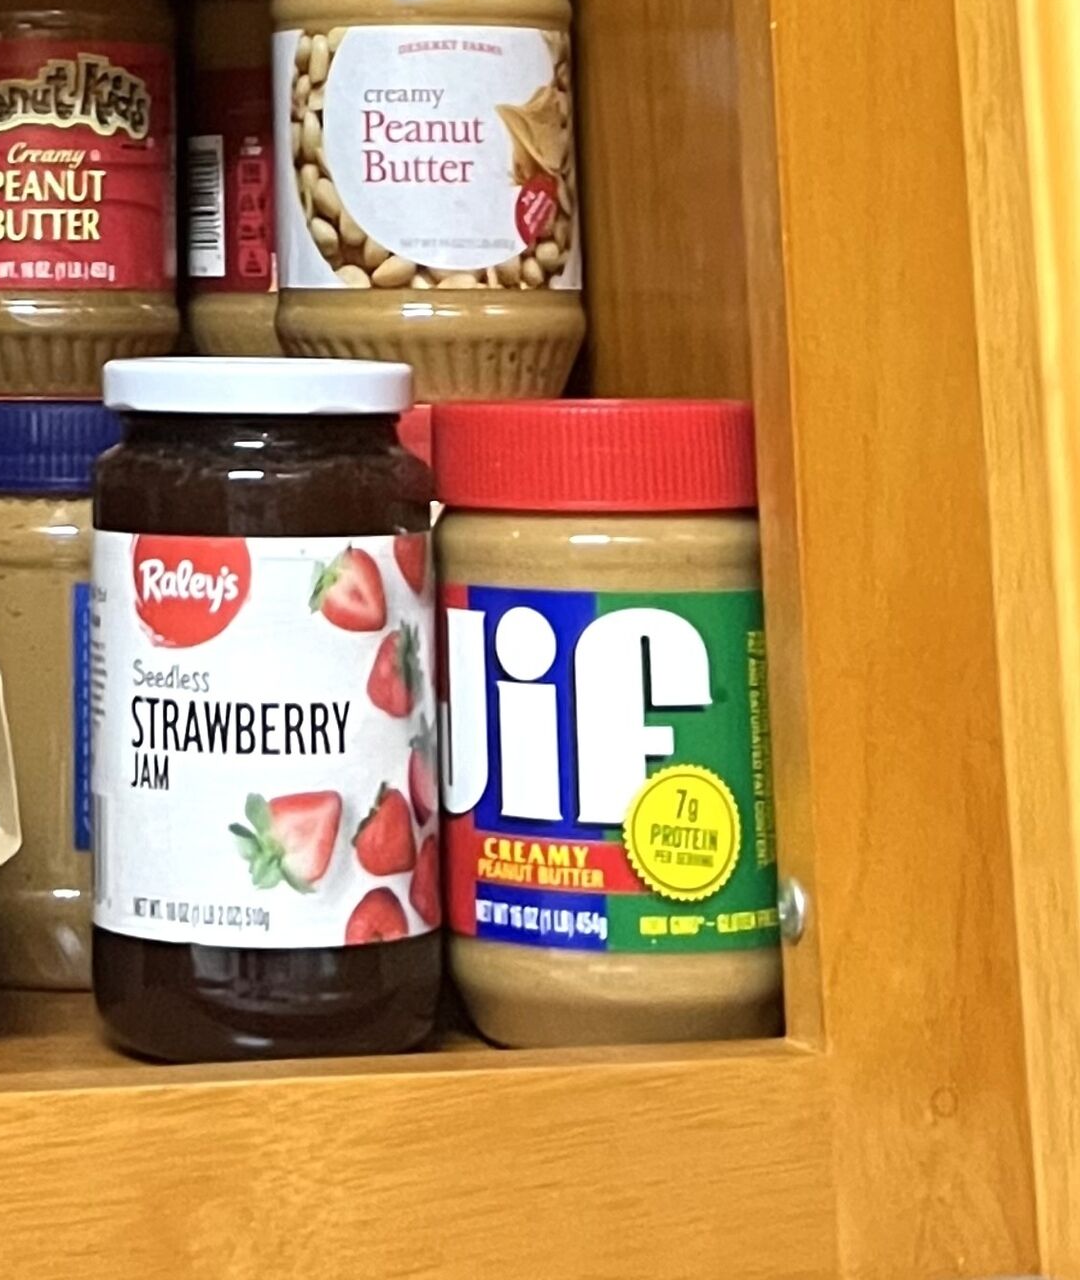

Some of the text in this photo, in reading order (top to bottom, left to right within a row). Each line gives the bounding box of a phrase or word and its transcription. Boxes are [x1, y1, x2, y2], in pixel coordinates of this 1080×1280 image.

[363, 88, 446, 109] creamy
[361, 110, 486, 145] Peanut
[7, 141, 88, 168] Creamy
[362, 148, 476, 184] Butter
[138, 558, 239, 613] Raley's
[132, 659, 211, 694] Seedless
[130, 696, 351, 756] STRAWBERRY
[445, 606, 713, 826] Jif
[130, 757, 171, 792] JAM
[676, 788, 699, 823] 7g
[483, 837, 589, 868] CREAMY
[649, 823, 719, 852] PROTEIN
[477, 858, 605, 889] PEANUT BUTTER
